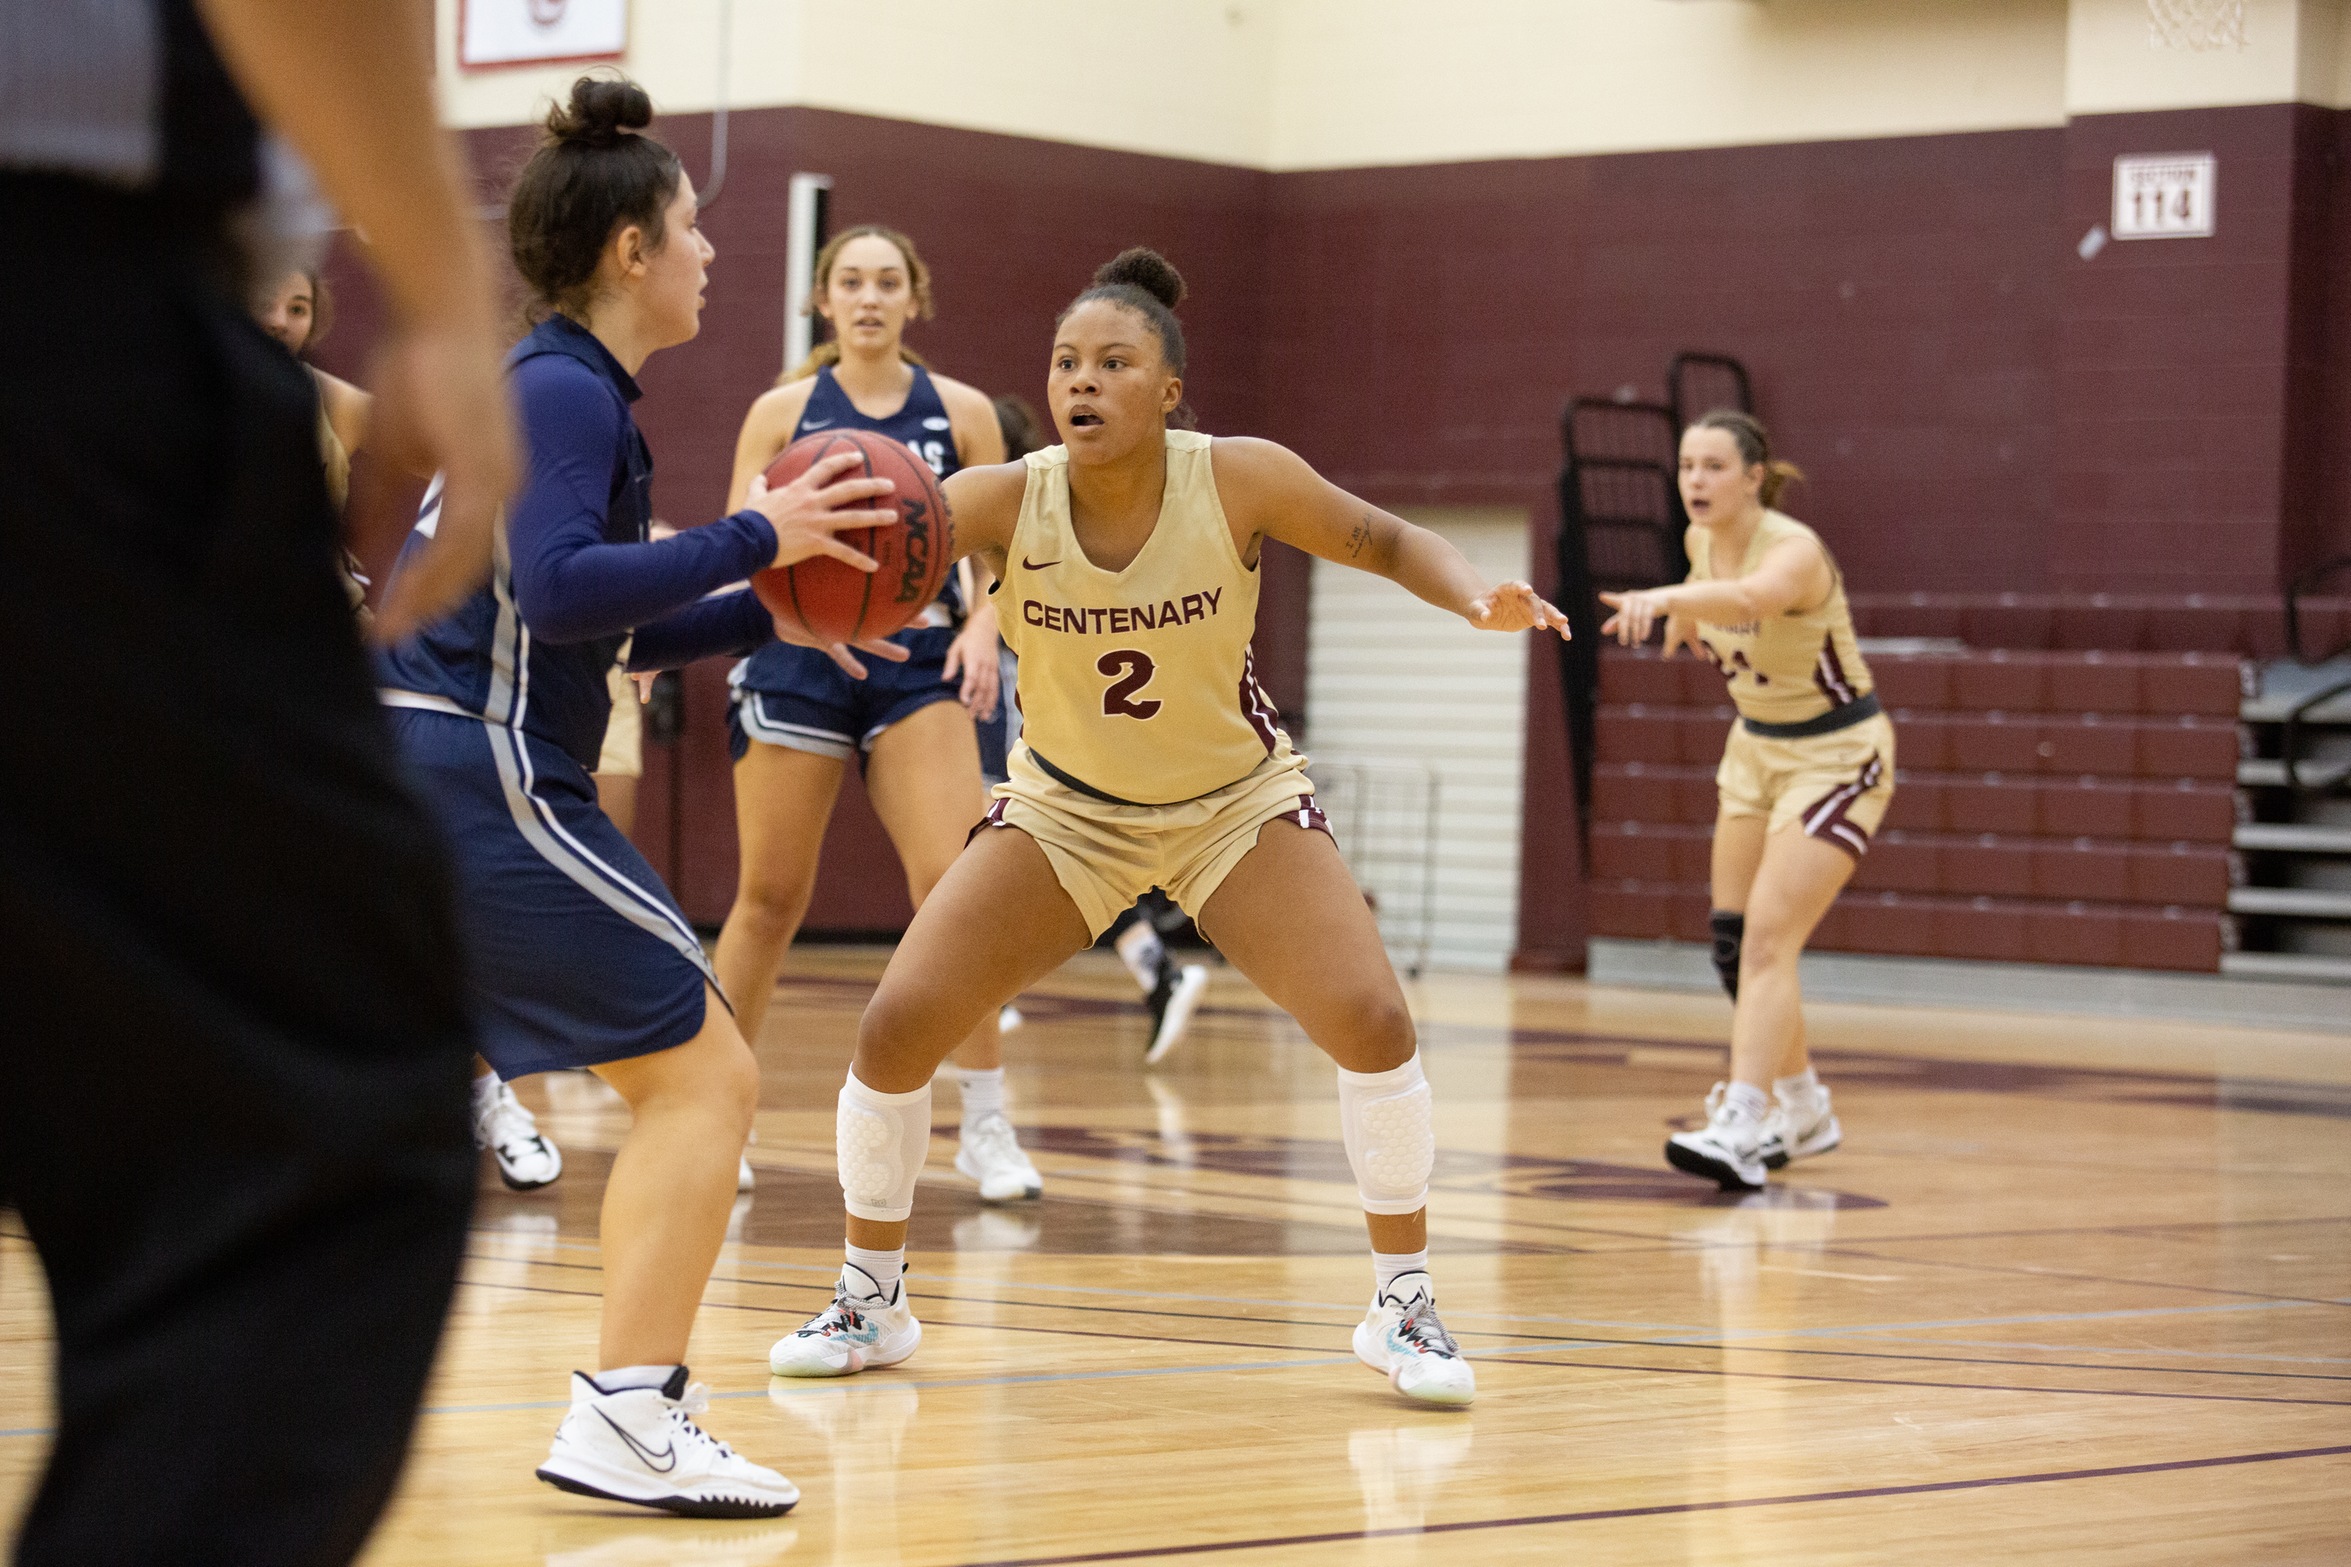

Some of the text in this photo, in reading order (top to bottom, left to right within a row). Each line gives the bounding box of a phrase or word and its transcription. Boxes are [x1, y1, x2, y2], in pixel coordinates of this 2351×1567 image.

[2132, 189, 2192, 224] 114
[894, 499, 928, 603] NCAA
[1023, 586, 1223, 635] CENTENARY
[1095, 648, 1164, 720] 2
